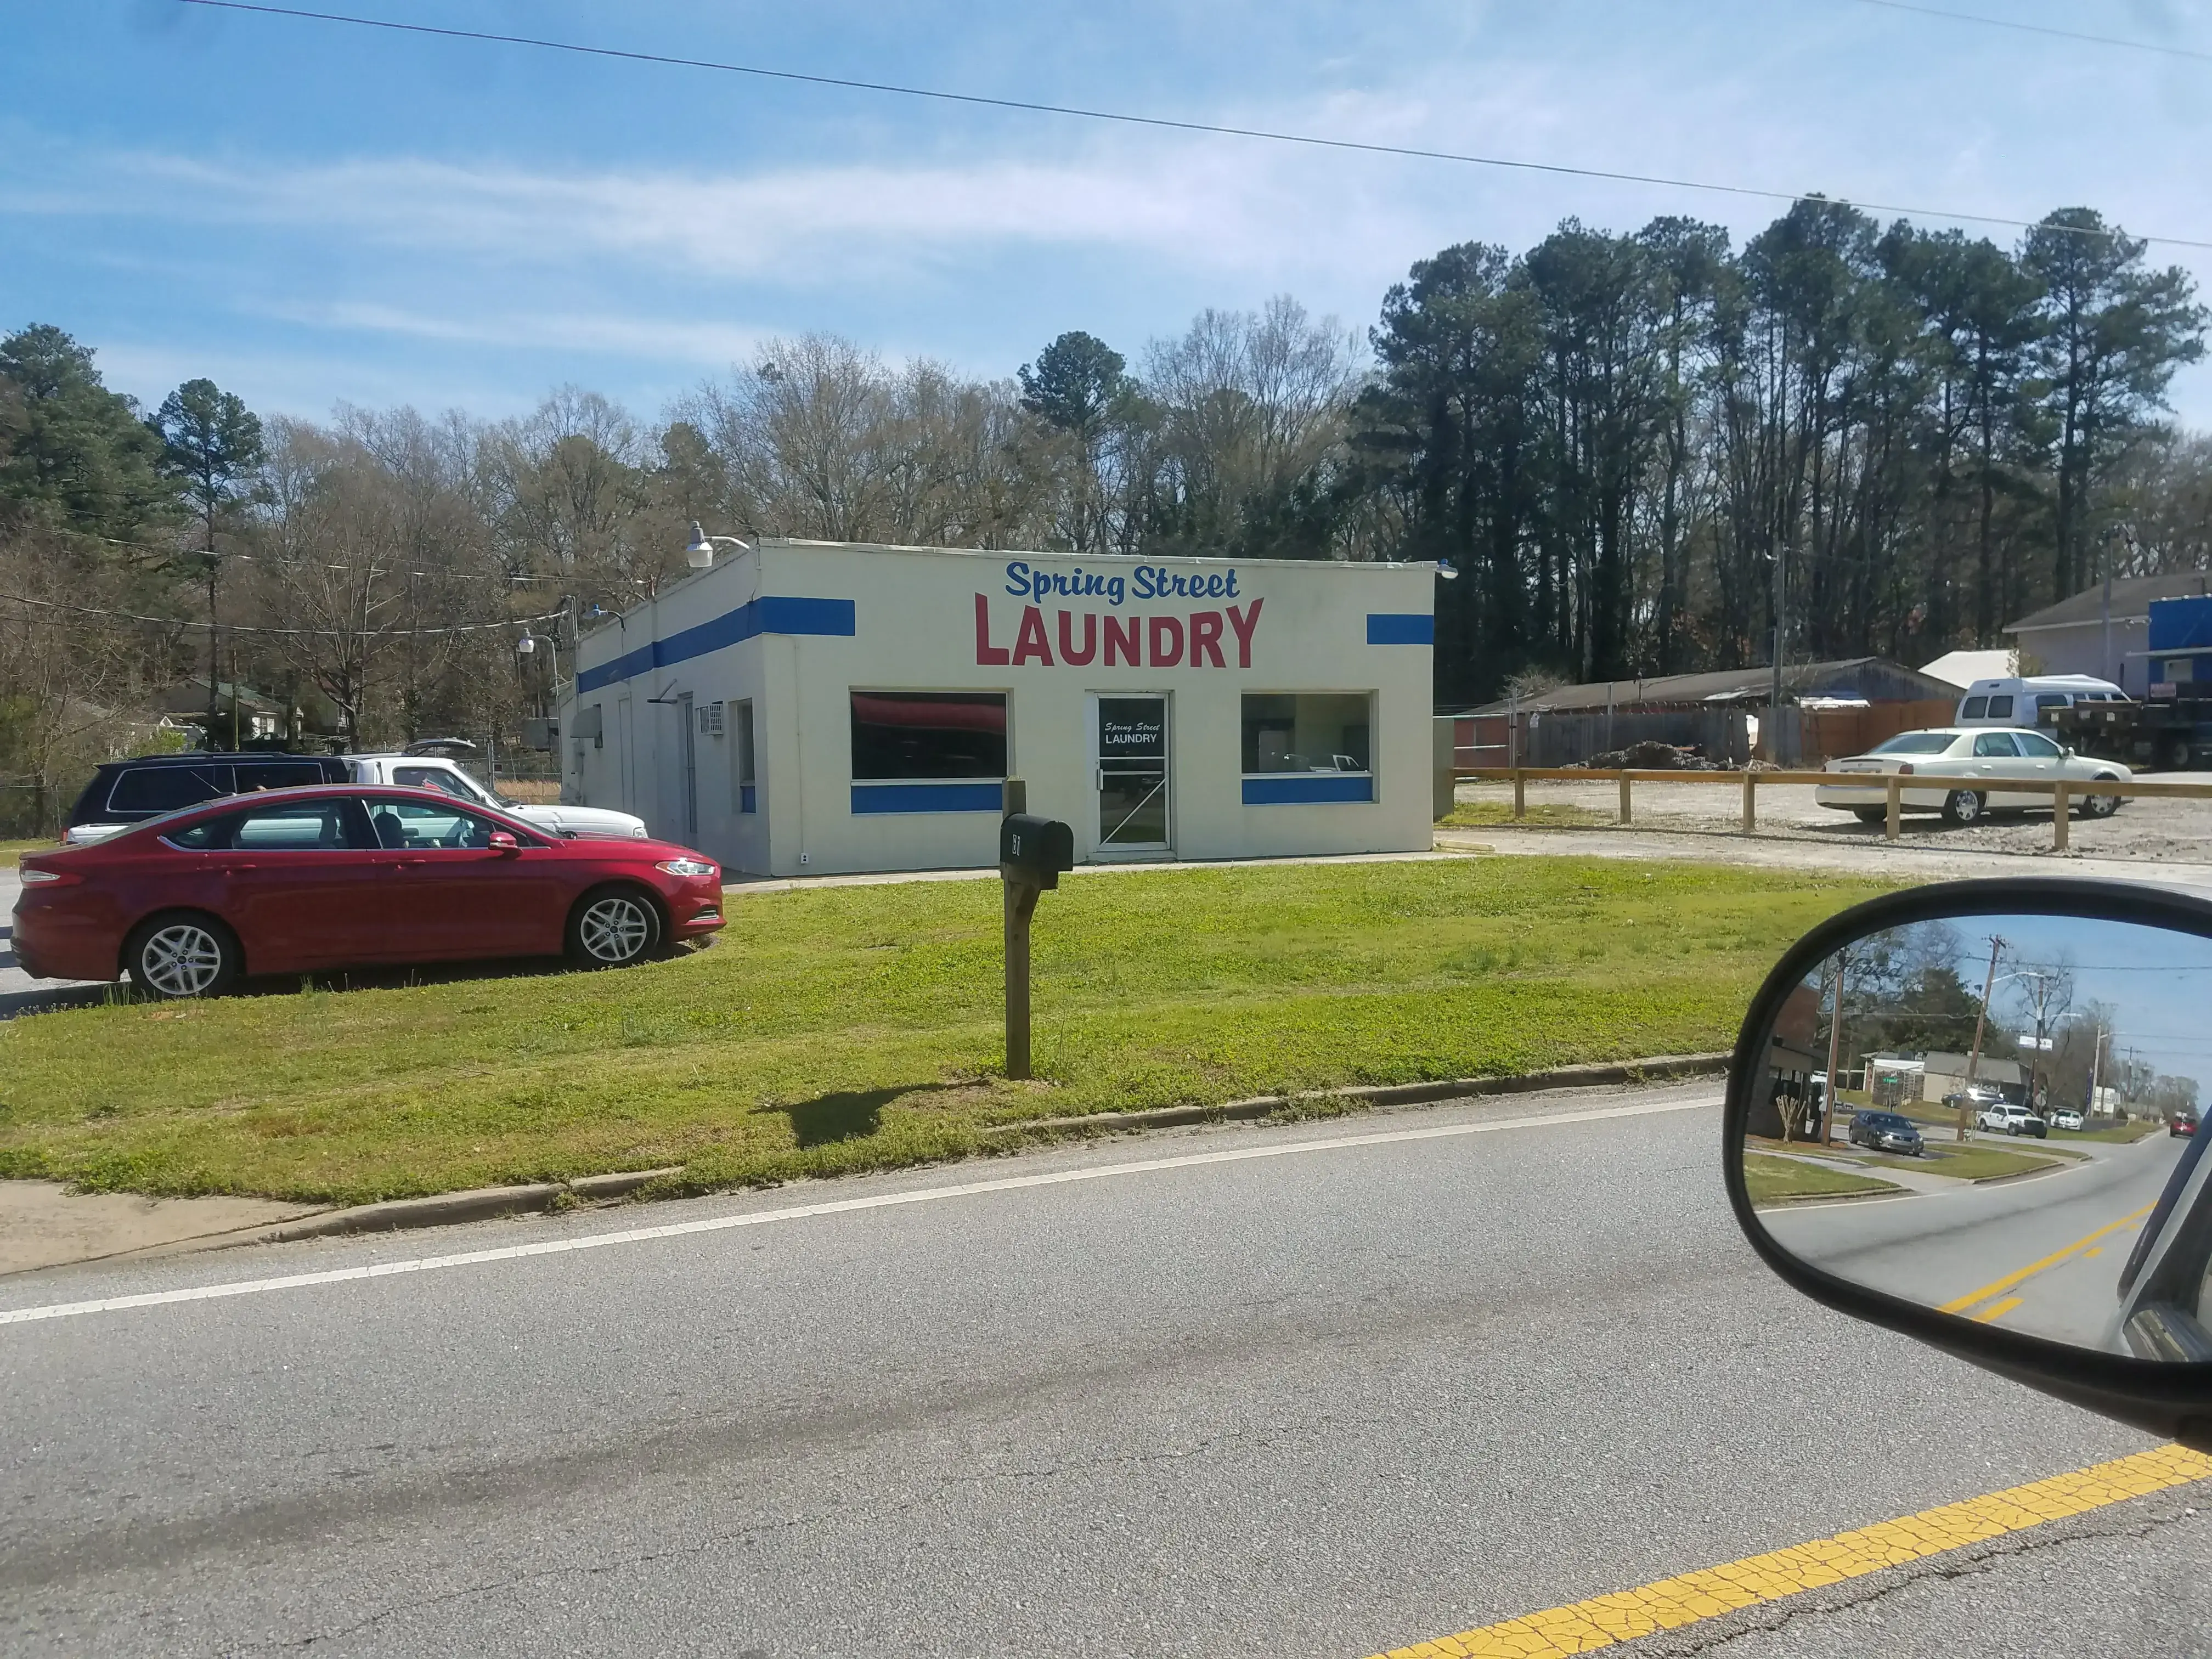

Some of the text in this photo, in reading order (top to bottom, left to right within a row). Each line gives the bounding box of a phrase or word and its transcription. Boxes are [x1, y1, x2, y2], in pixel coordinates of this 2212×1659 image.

[1005, 562, 1240, 606] Spring Street
[974, 592, 1265, 668] LAUNDRY
[1105, 722, 1161, 732] Spring Street
[1105, 733, 1157, 744] LAUNDRY
